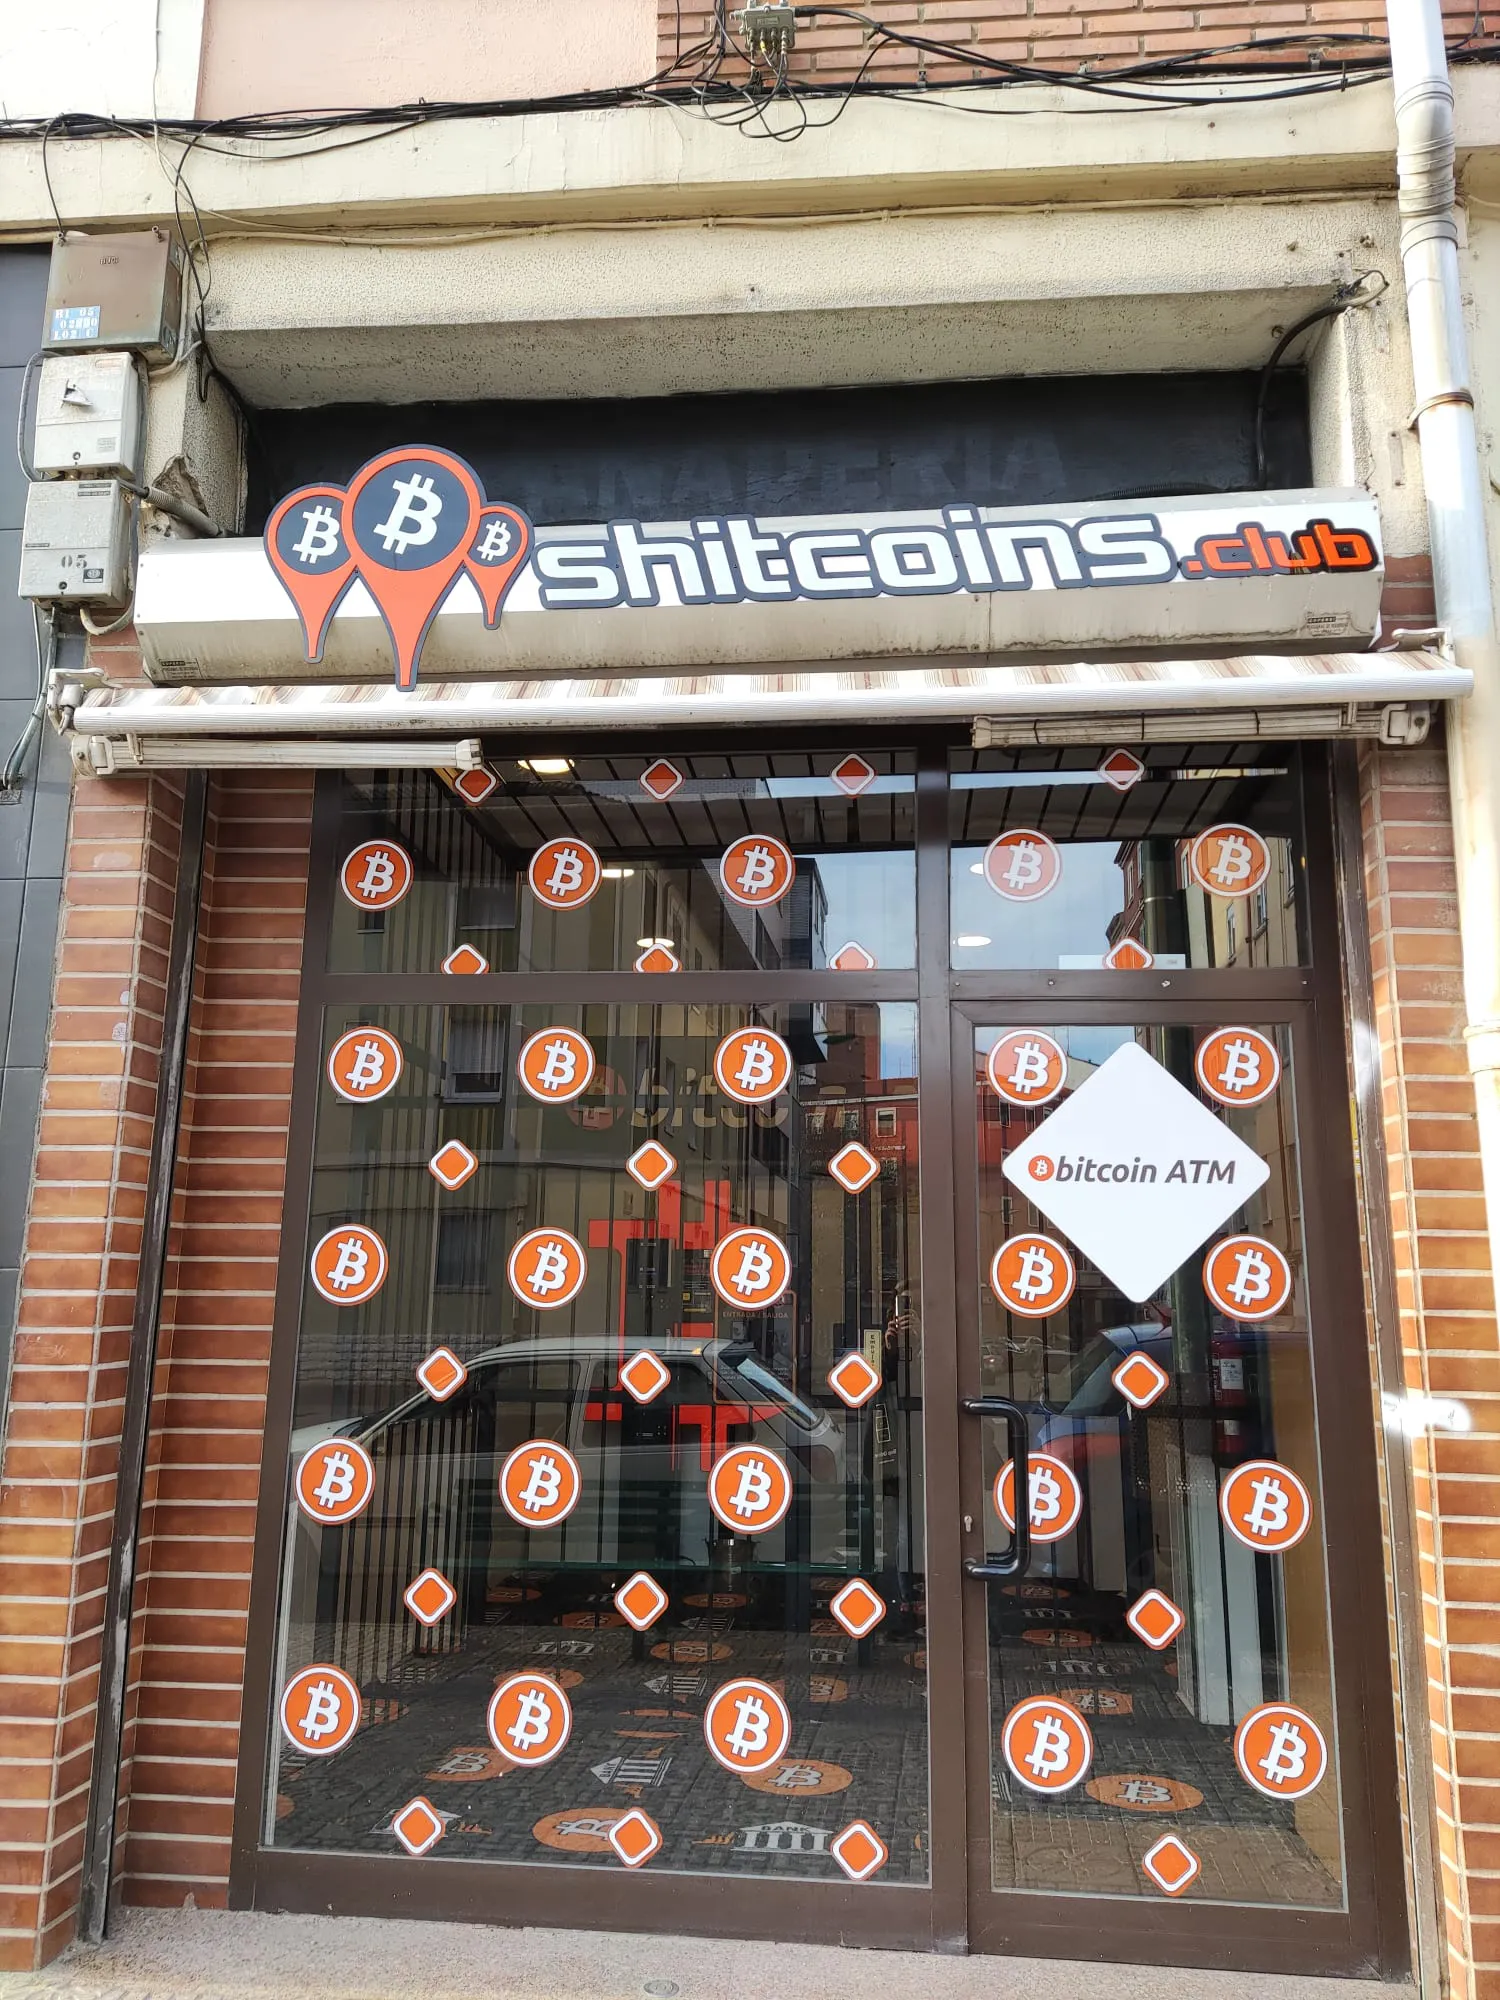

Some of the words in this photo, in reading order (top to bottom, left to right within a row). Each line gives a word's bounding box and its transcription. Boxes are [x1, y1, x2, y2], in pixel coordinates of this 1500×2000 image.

[1055, 1155, 1157, 1183] bitcoin
[1164, 1159, 1236, 1184] ATM
[761, 1825, 810, 1834] BANK
